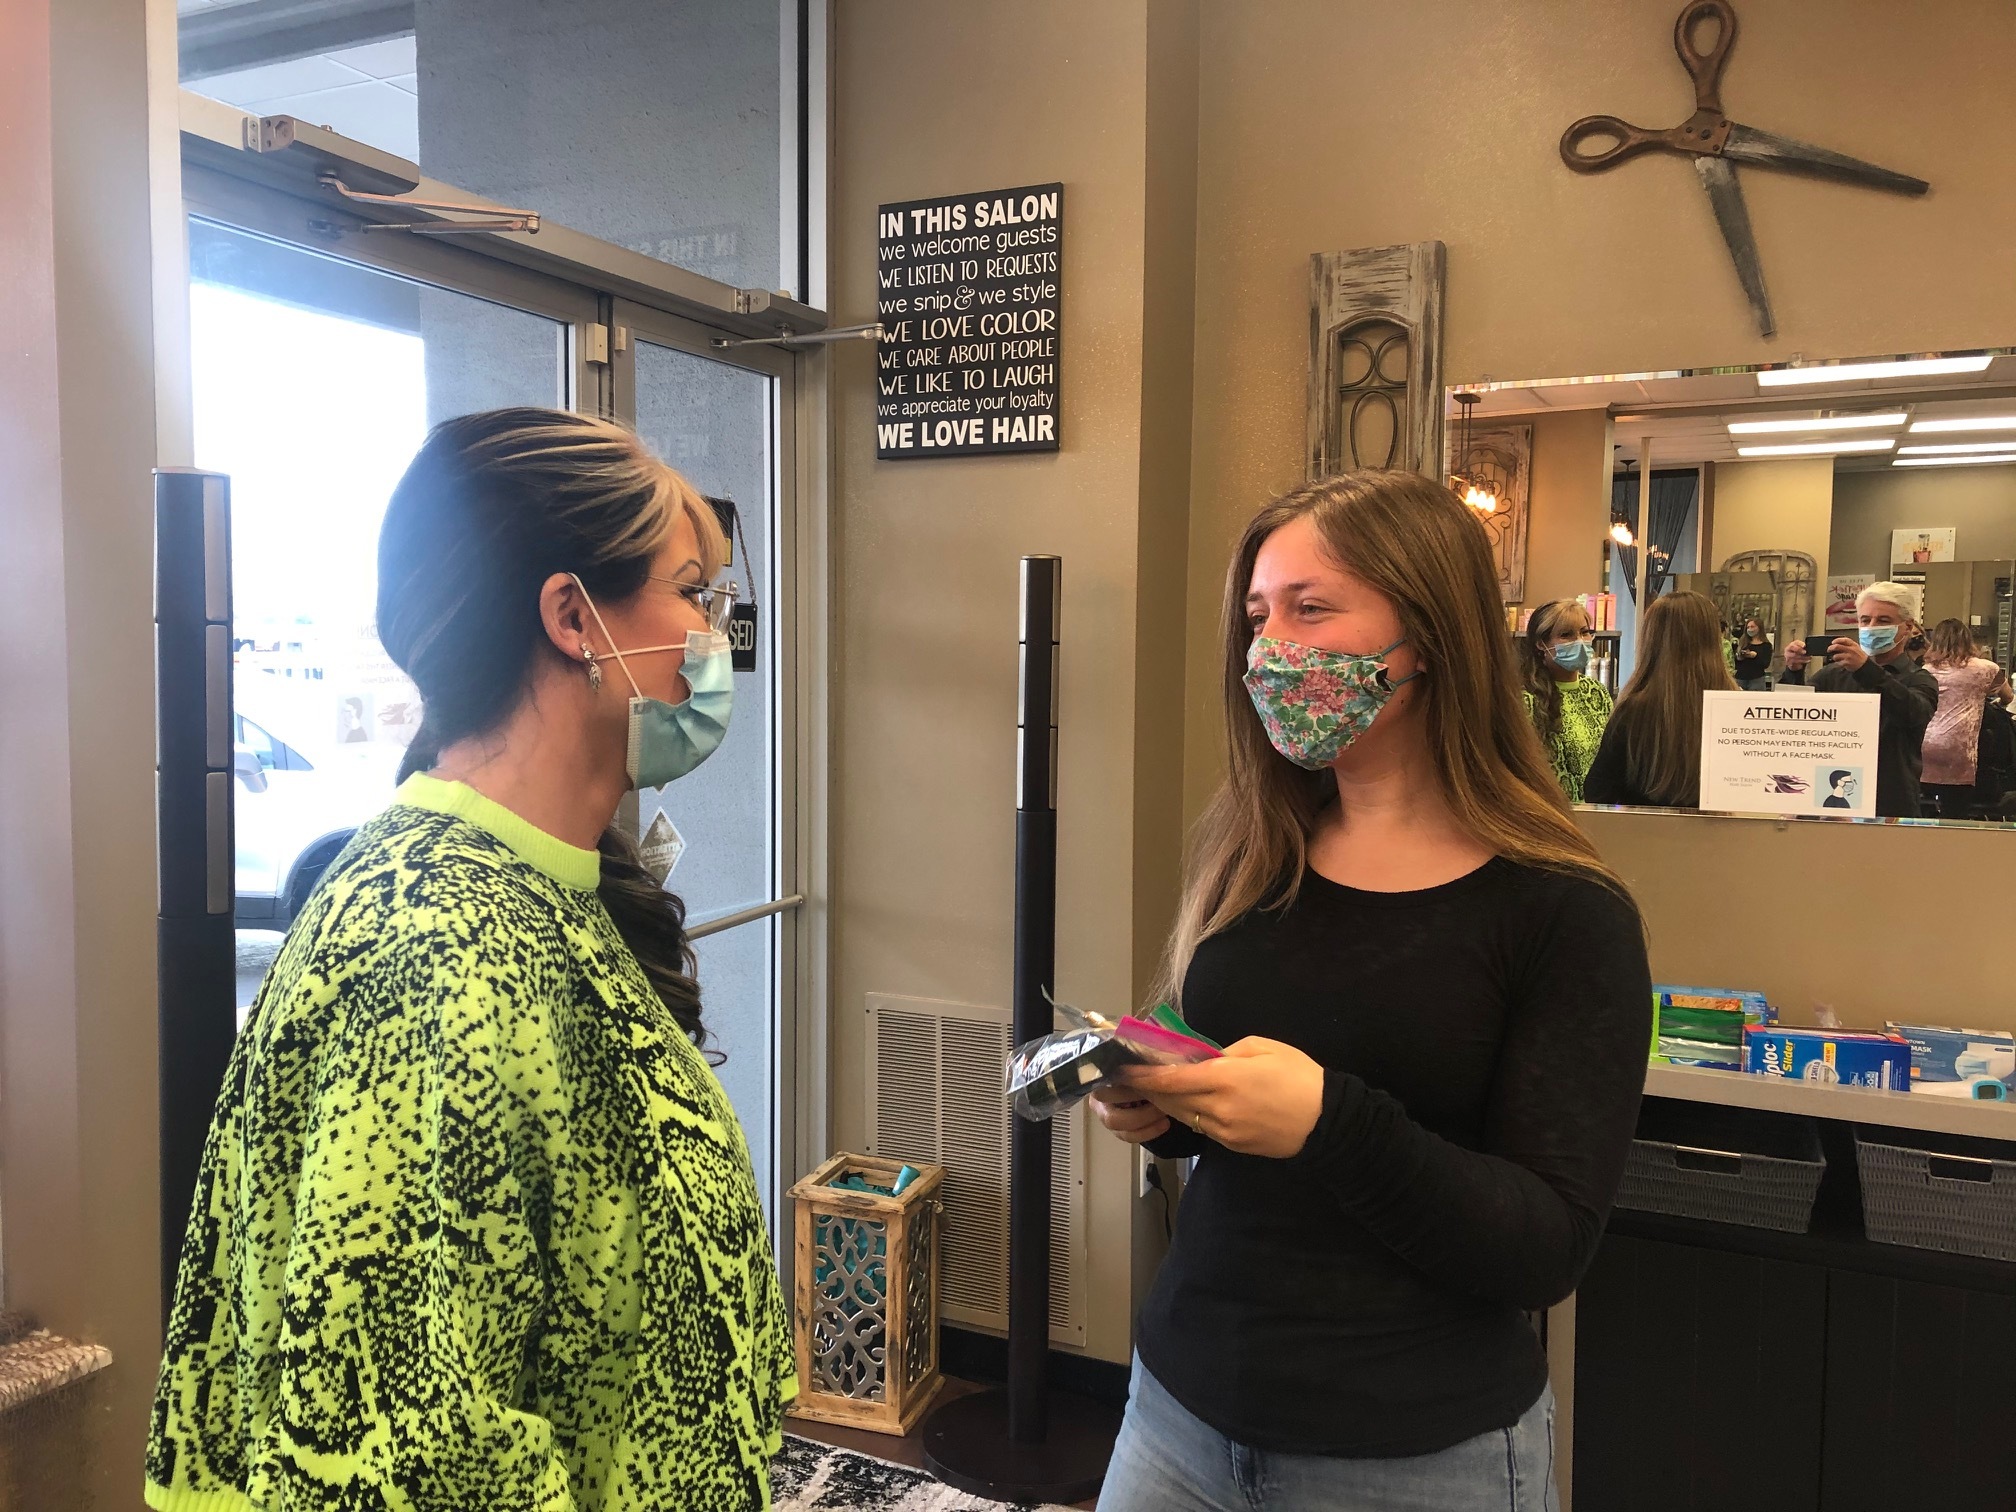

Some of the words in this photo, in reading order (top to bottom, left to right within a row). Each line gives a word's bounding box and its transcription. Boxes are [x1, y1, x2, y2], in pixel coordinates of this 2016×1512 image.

[880, 212, 904, 238] IN
[911, 205, 967, 234] THIS
[974, 192, 1057, 228] SALON
[880, 244, 905, 261] we
[912, 235, 990, 257] welcome
[996, 224, 1056, 253] guests
[879, 267, 902, 288] WE
[908, 263, 953, 286] LISTEN
[960, 260, 978, 280] TO
[987, 252, 1056, 279] REQUESTS
[879, 298, 907, 314] we
[914, 293, 951, 312] snip
[954, 285, 975, 311] &
[979, 289, 1006, 304] we
[1013, 281, 1055, 304] style
[882, 320, 913, 343] WE
[922, 315, 974, 341] LOVE
[981, 309, 1055, 335] COLOR
[879, 350, 901, 369] WE
[907, 349, 942, 367] CARE
[949, 342, 996, 364] ABOUT
[1002, 337, 1054, 360] PEOPLE
[879, 374, 908, 396] WE
[916, 371, 953, 393] LIKE
[962, 369, 984, 390] TO
[994, 364, 1053, 388] LAUGH
[878, 404, 897, 416] we
[902, 396, 970, 418] appreciate
[975, 396, 1006, 413] your
[1010, 389, 1054, 410] loyalty
[878, 423, 913, 449] WE
[921, 419, 984, 447] LOVE
[993, 414, 1054, 444] HAIR
[729, 619, 754, 650] SED
[1744, 707, 1837, 722] ATTENTION!
[1801, 730, 1860, 738] REGULATIONS,
[1758, 1043, 1785, 1076] iploc
[1783, 1039, 1794, 1072] Slider
